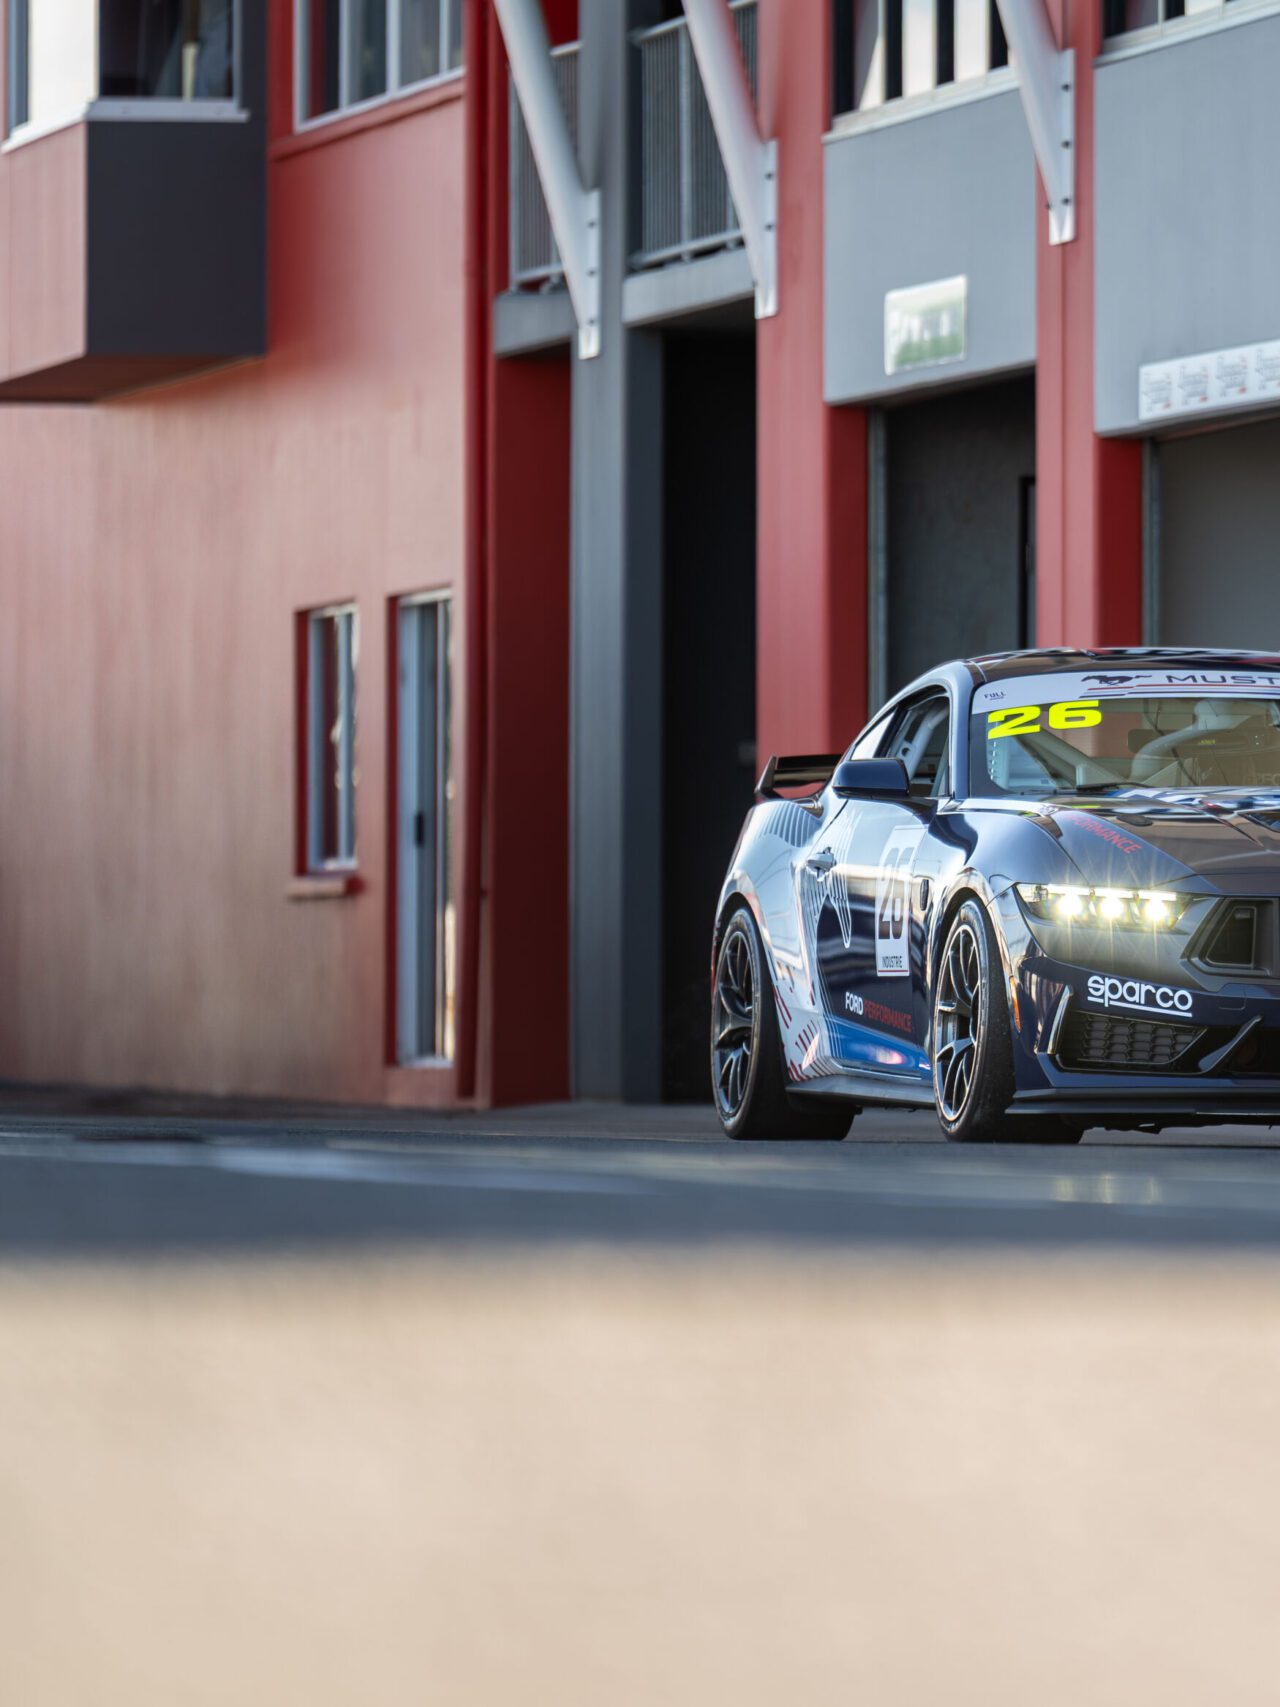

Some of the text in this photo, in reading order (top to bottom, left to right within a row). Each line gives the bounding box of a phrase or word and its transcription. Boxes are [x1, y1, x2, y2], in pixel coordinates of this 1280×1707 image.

[987, 700, 1102, 740] 26
[878, 847, 915, 939] 26
[845, 991, 864, 1015] FORD
[1087, 975, 1193, 1012] sparco
